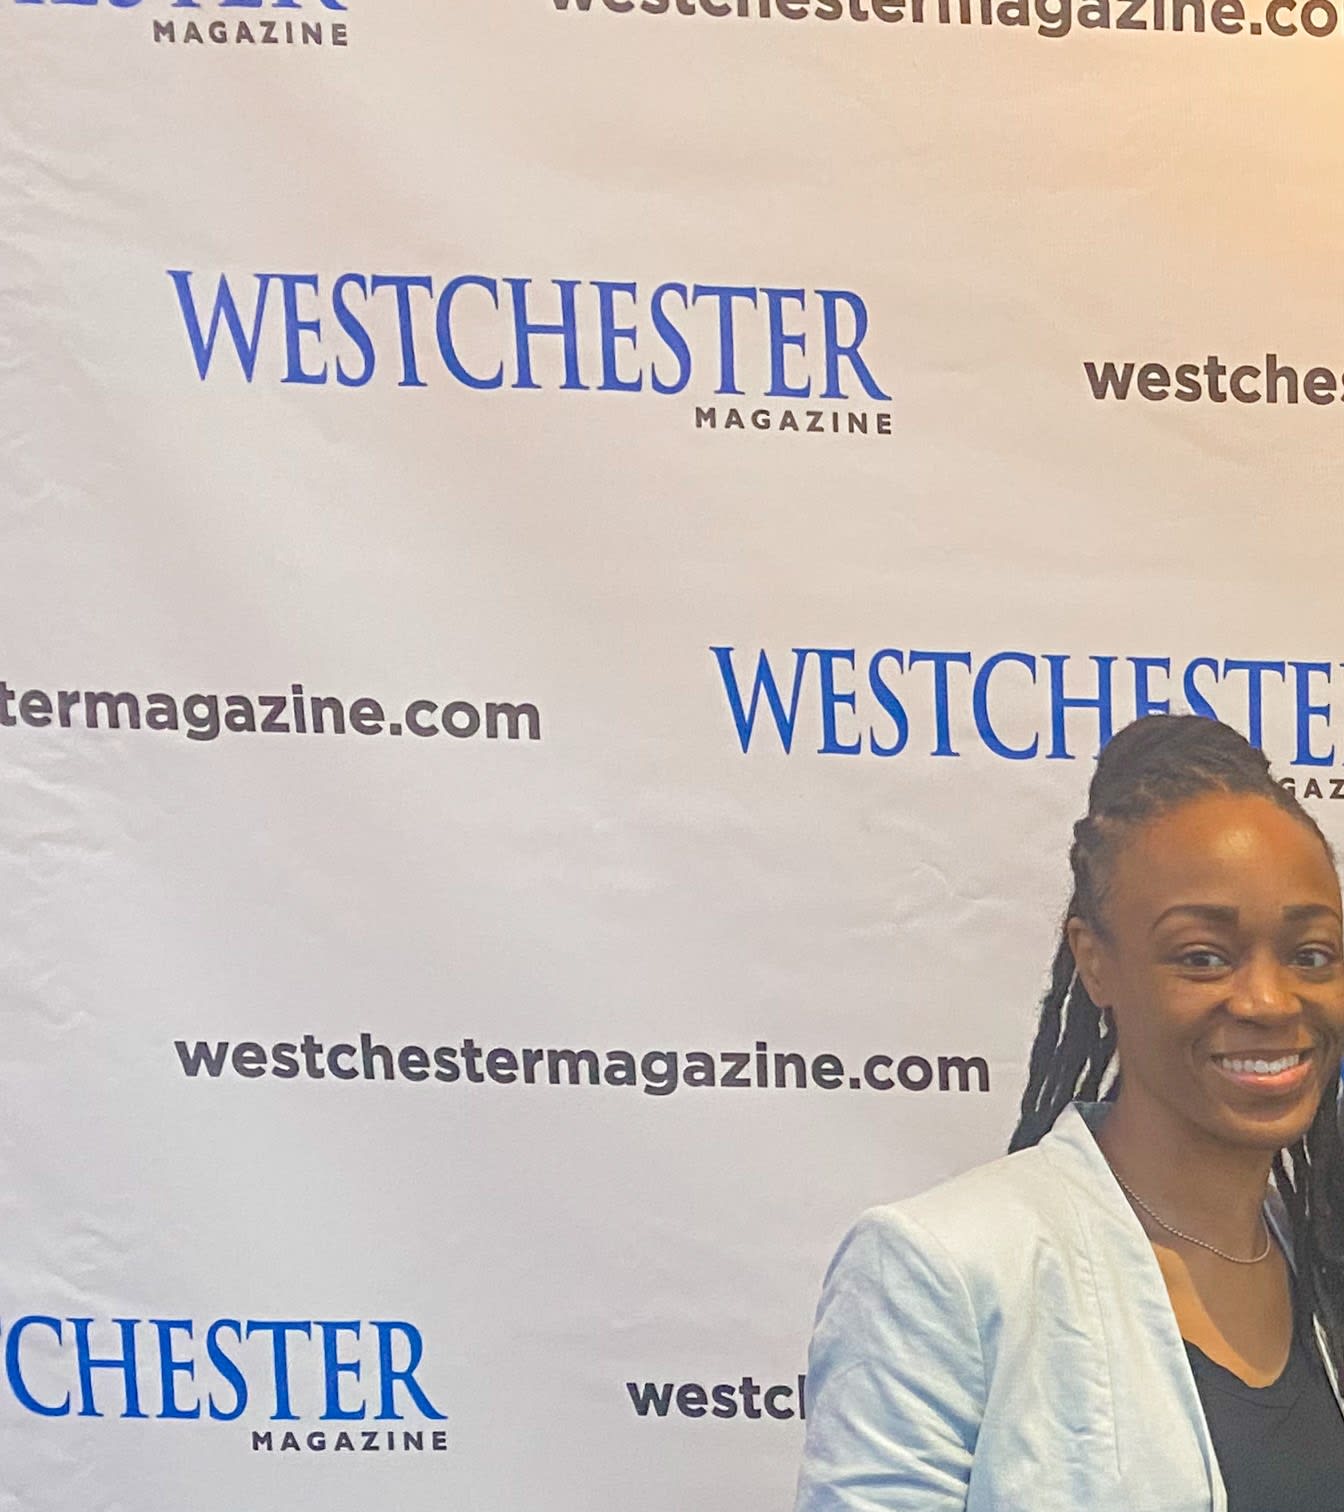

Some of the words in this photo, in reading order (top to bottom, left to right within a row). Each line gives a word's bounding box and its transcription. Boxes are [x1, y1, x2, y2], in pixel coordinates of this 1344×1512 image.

[155, 21, 348, 47] MAGAZINE
[169, 272, 893, 401] WESTCHESTER
[697, 408, 892, 435] MAGAZINE
[176, 1034, 990, 1096] westchestermagazine.com
[0, 1315, 448, 1422] CHESTER
[254, 1433, 448, 1452] MAGAZINE
